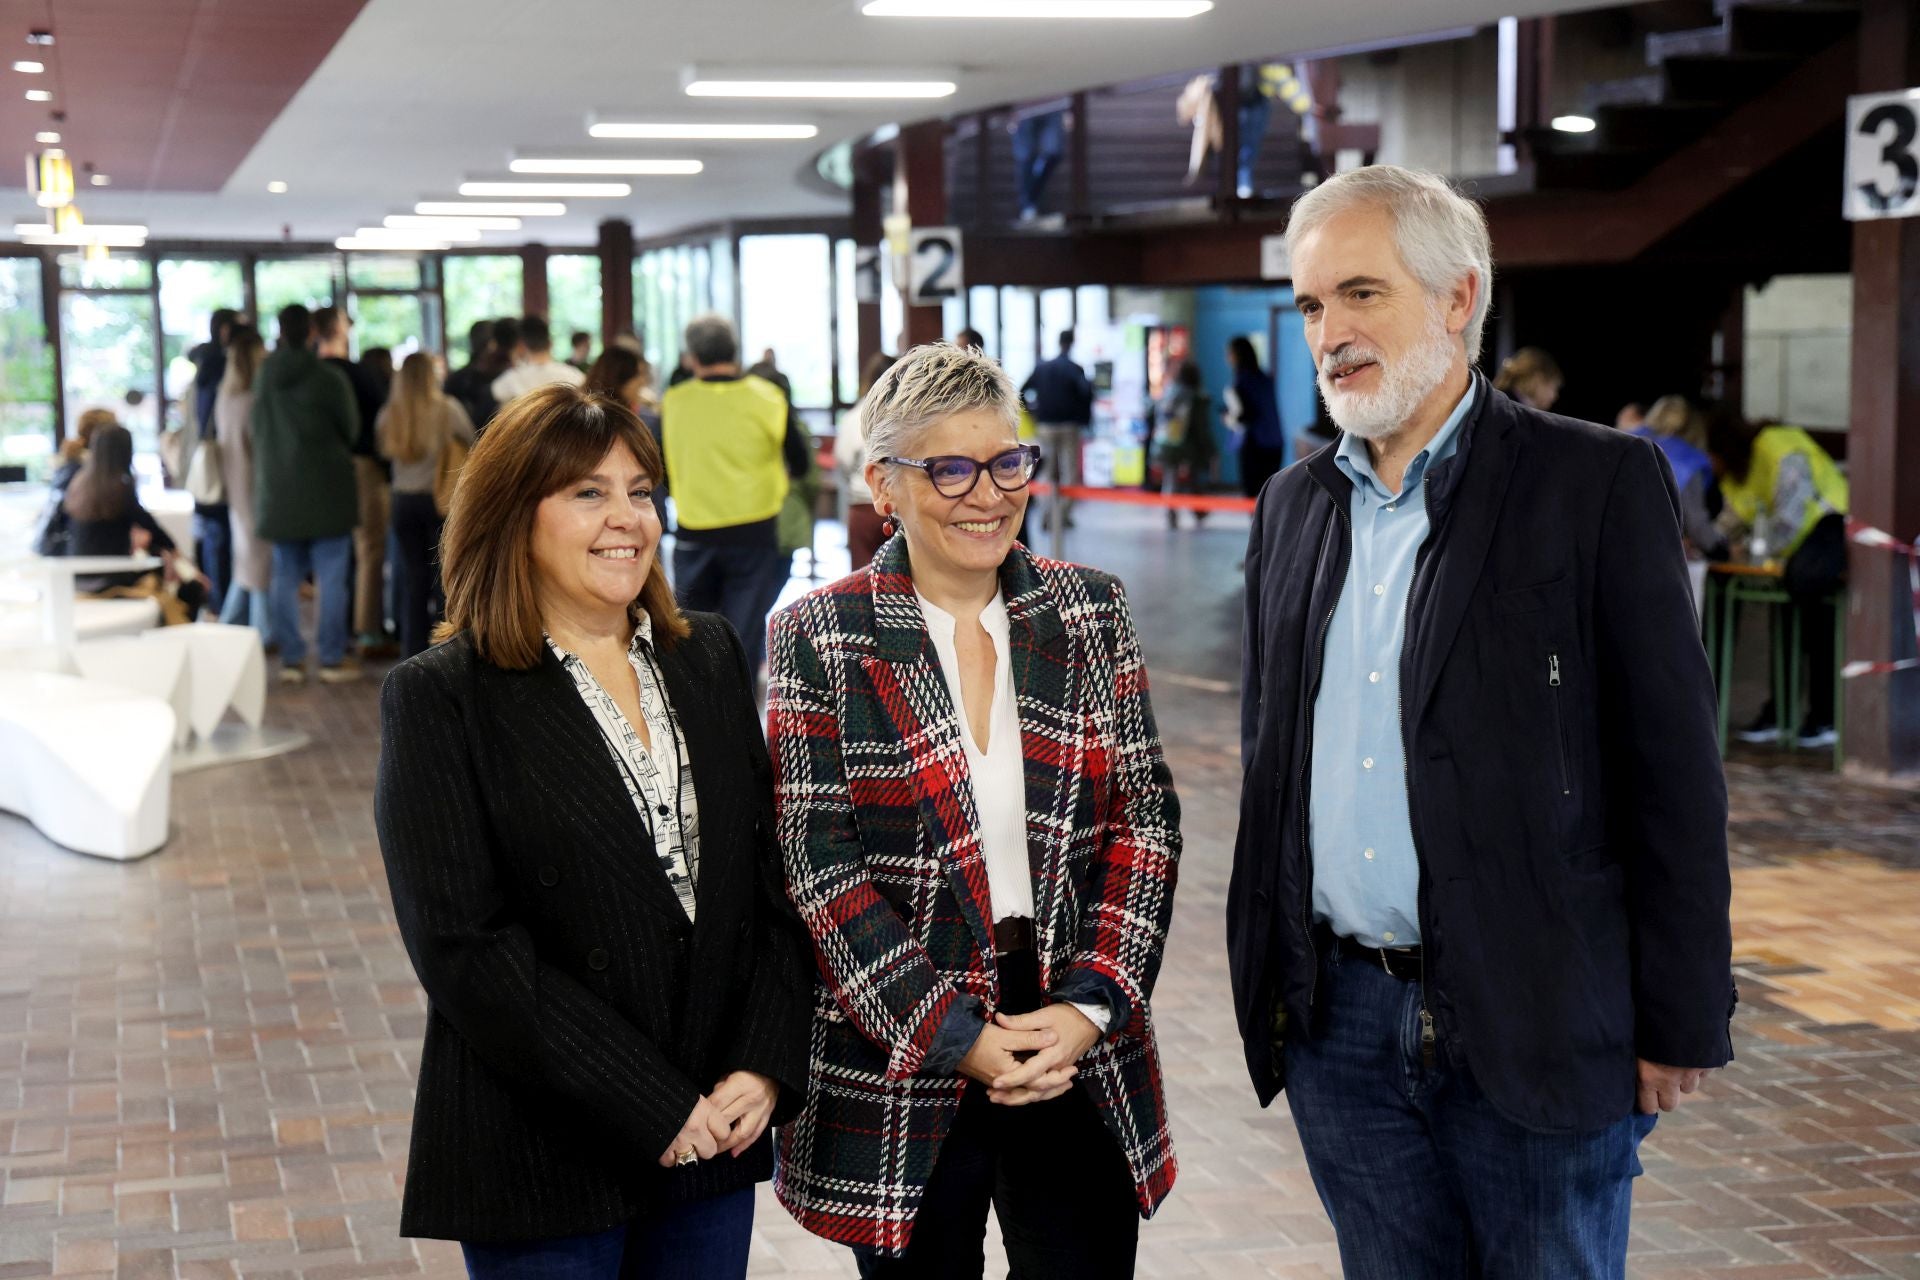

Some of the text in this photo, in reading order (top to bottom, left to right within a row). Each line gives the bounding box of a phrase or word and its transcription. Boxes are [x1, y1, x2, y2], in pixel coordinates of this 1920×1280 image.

[1858, 105, 1918, 210] 3
[857, 255, 881, 296] 1
[917, 238, 956, 297] 2
